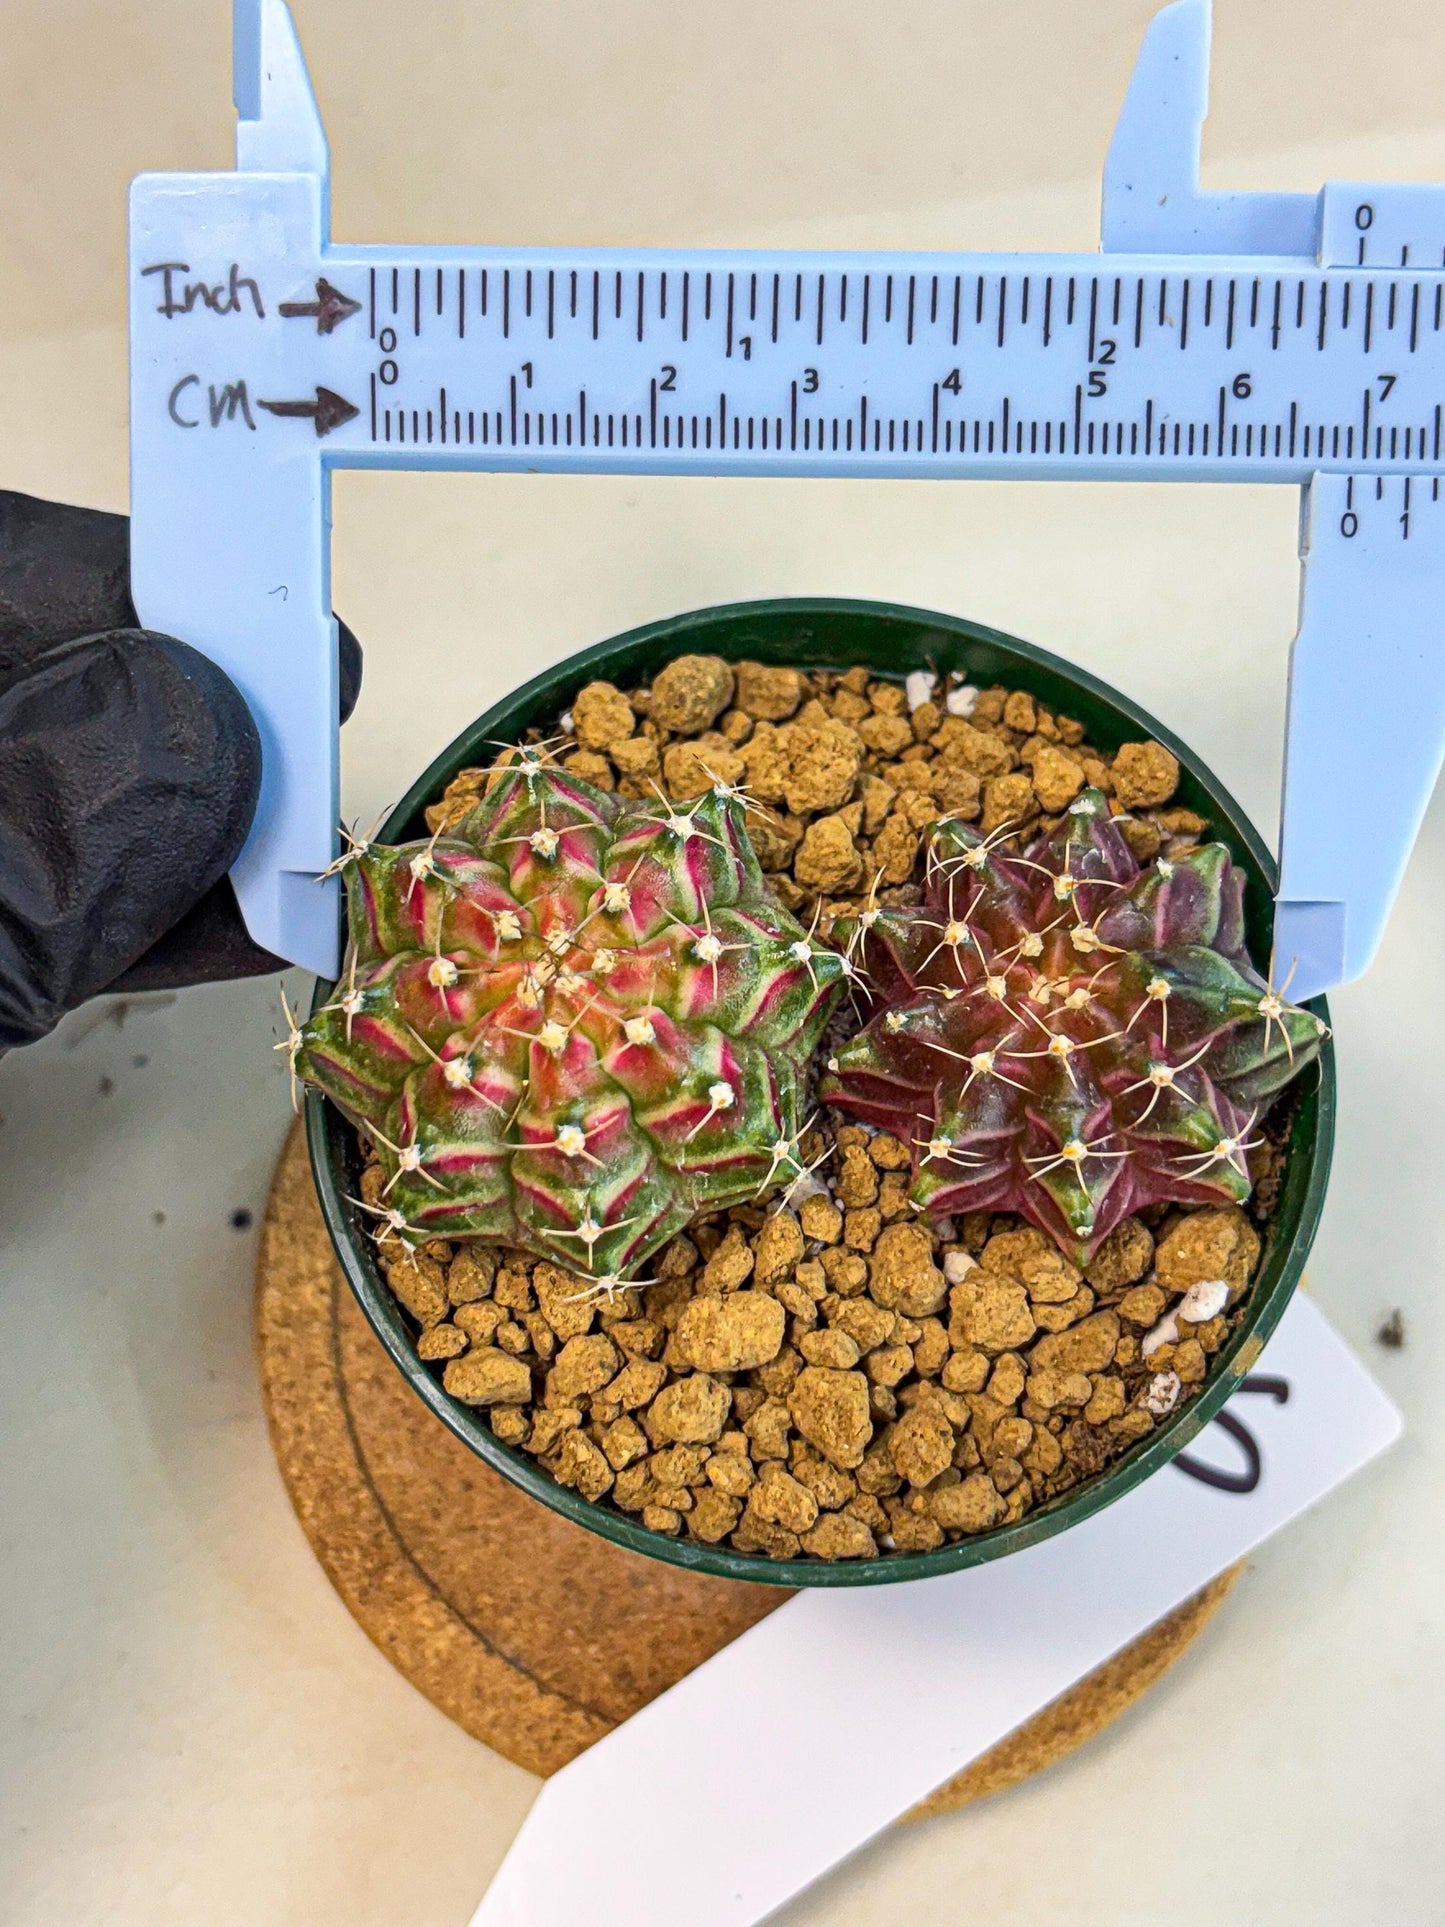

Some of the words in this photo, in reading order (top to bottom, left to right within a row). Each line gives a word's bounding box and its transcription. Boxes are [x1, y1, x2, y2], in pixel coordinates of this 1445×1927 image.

[1354, 203, 1374, 231] 0
[142, 263, 266, 319] Inch
[378, 327, 397, 353] 0
[738, 336, 752, 362] 1
[1097, 340, 1117, 366] 2
[379, 359, 398, 385] 0
[520, 361, 533, 389] 1
[659, 365, 677, 392] 2
[802, 367, 820, 394] 3
[941, 368, 963, 396] 4
[1088, 370, 1108, 398] 5
[1231, 372, 1251, 400] 6
[1377, 375, 1397, 402] 7
[1341, 513, 1359, 539] 0
[1400, 512, 1410, 540] 1
